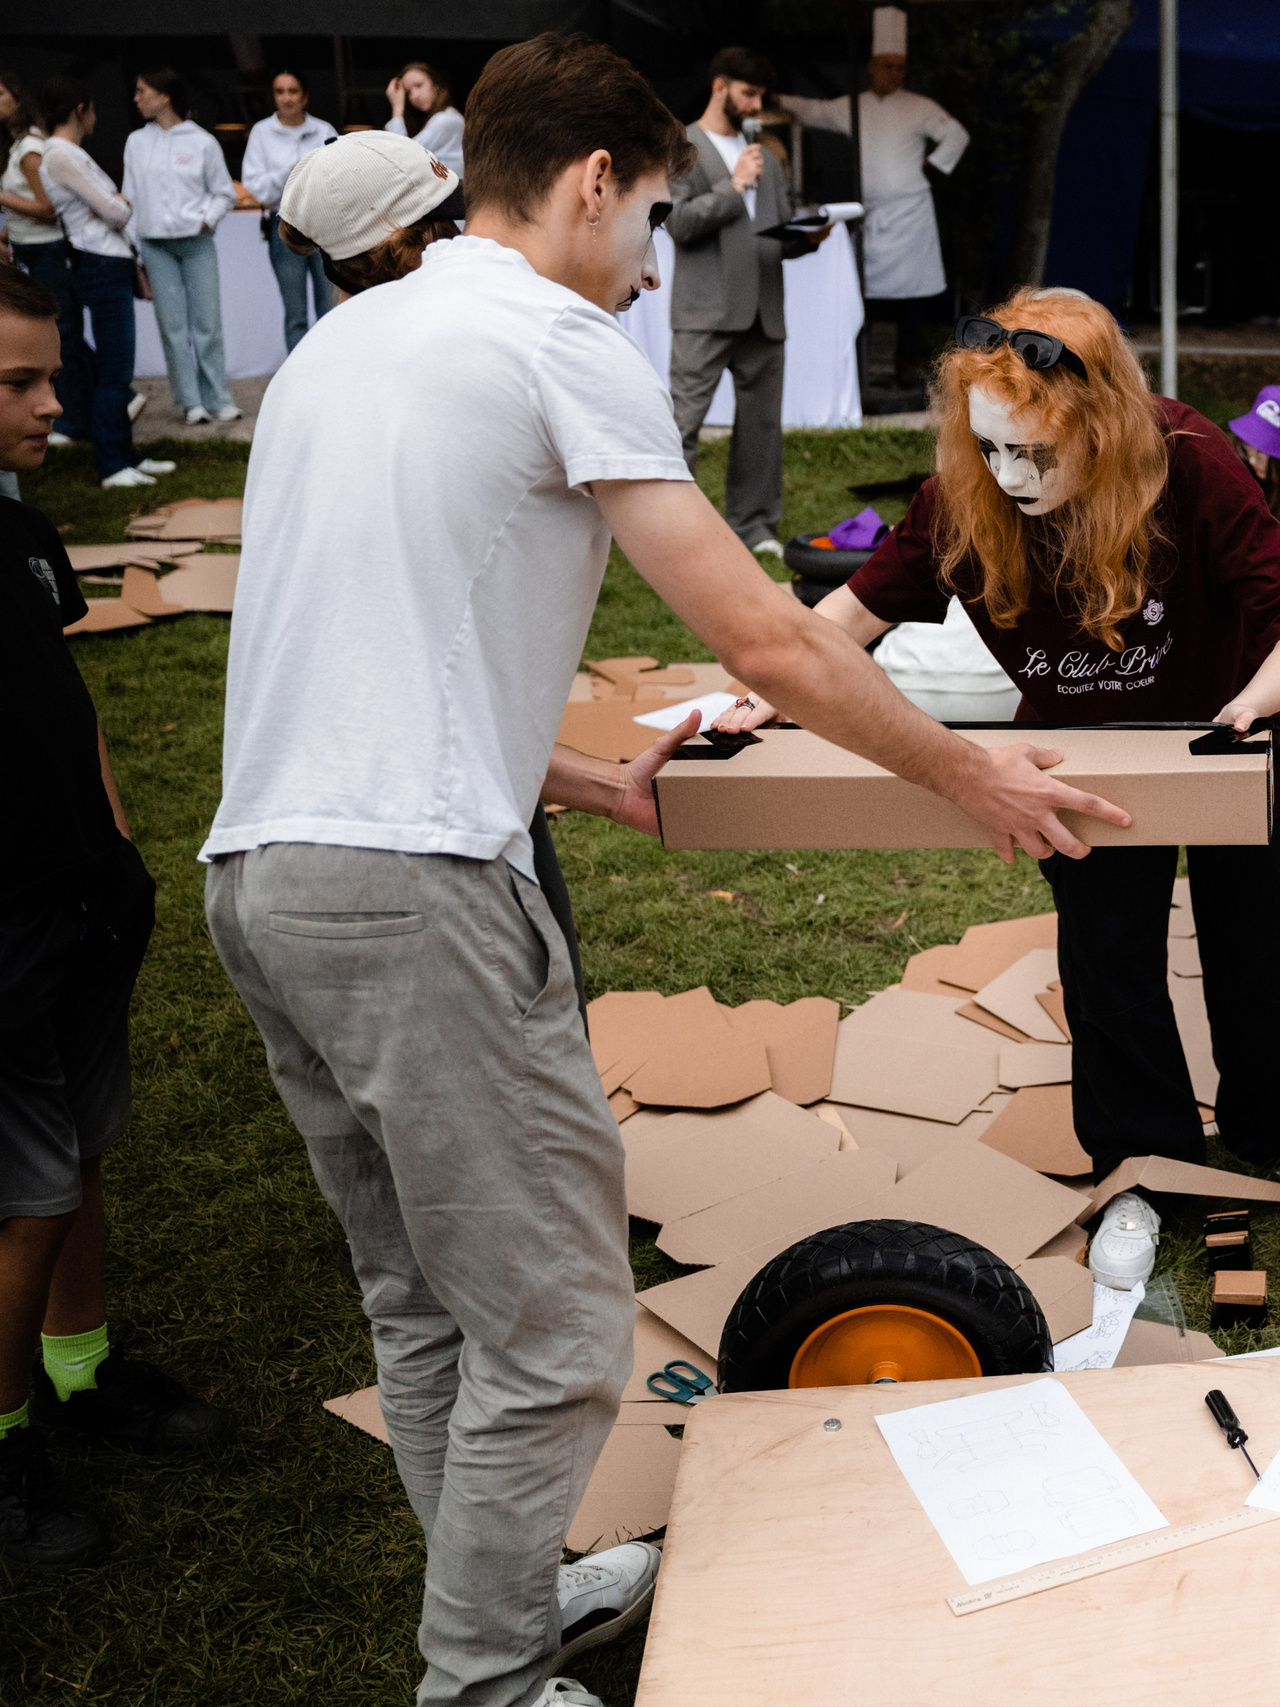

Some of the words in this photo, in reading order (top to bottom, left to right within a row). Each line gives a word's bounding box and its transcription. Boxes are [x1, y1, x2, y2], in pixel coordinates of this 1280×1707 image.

[1018, 647, 1051, 679] Le
[1057, 651, 1116, 679] Club
[1057, 681, 1095, 695] ECOUTEZ
[1098, 679, 1123, 692] VOTRE
[1126, 675, 1156, 691] COEUR
